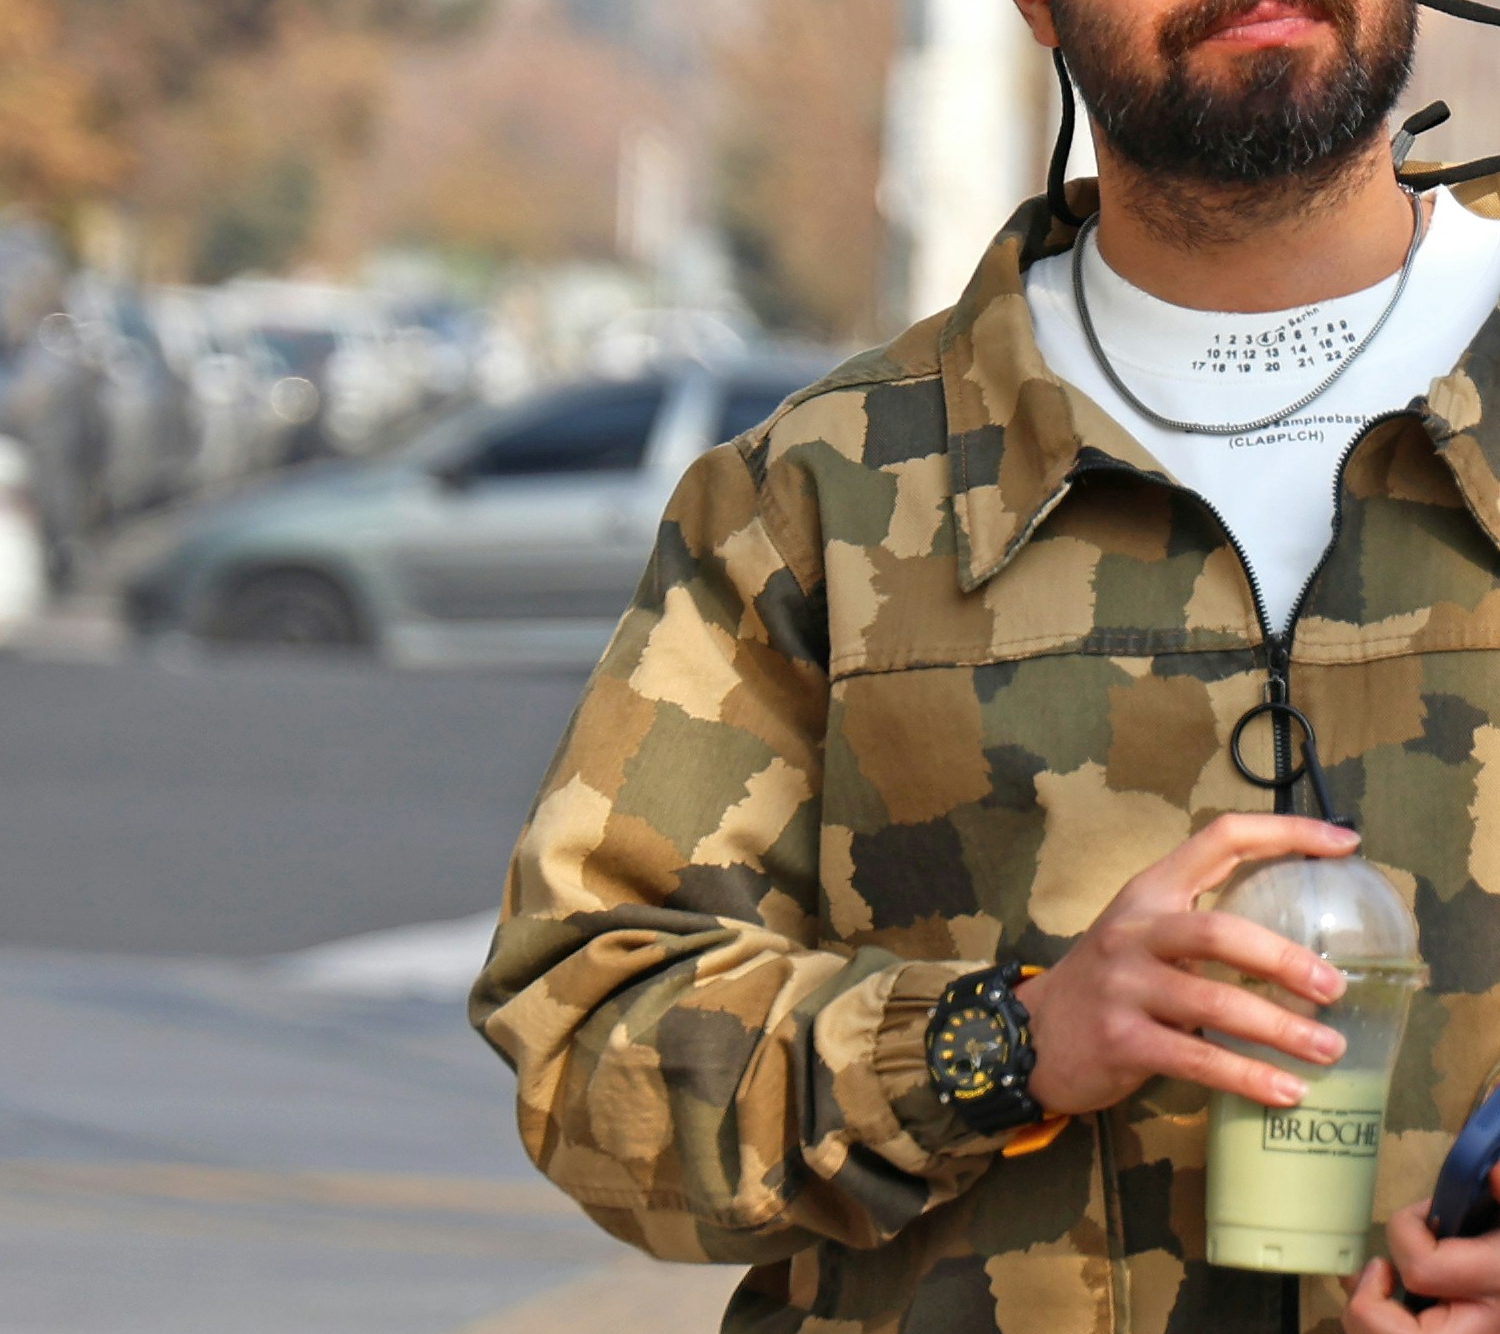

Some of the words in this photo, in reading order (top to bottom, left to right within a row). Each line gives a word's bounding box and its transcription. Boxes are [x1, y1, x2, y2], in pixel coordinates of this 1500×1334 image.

[1215, 334, 1220, 344] 1
[1229, 335, 1236, 345] 2
[1246, 335, 1252, 345] 3
[1262, 333, 1269, 343] 4
[1279, 332, 1286, 342] 5
[1295, 329, 1302, 340] 6
[1312, 326, 1318, 336] 7
[1327, 322, 1335, 333] 8
[1340, 320, 1348, 330] 9
[1207, 348, 1220, 359] 10
[1226, 349, 1237, 359] 11
[1243, 349, 1256, 359] 12
[1266, 348, 1279, 358] 13
[1291, 345, 1306, 355] 14
[1342, 333, 1355, 343] 16
[1192, 361, 1206, 370] 17
[1212, 363, 1226, 373] 18
[1237, 364, 1251, 373] 19
[1265, 362, 1280, 371] 20
[1298, 357, 1315, 367] 21
[1325, 349, 1342, 362] 22
[1228, 431, 1325, 449] (CLABPLCH)
